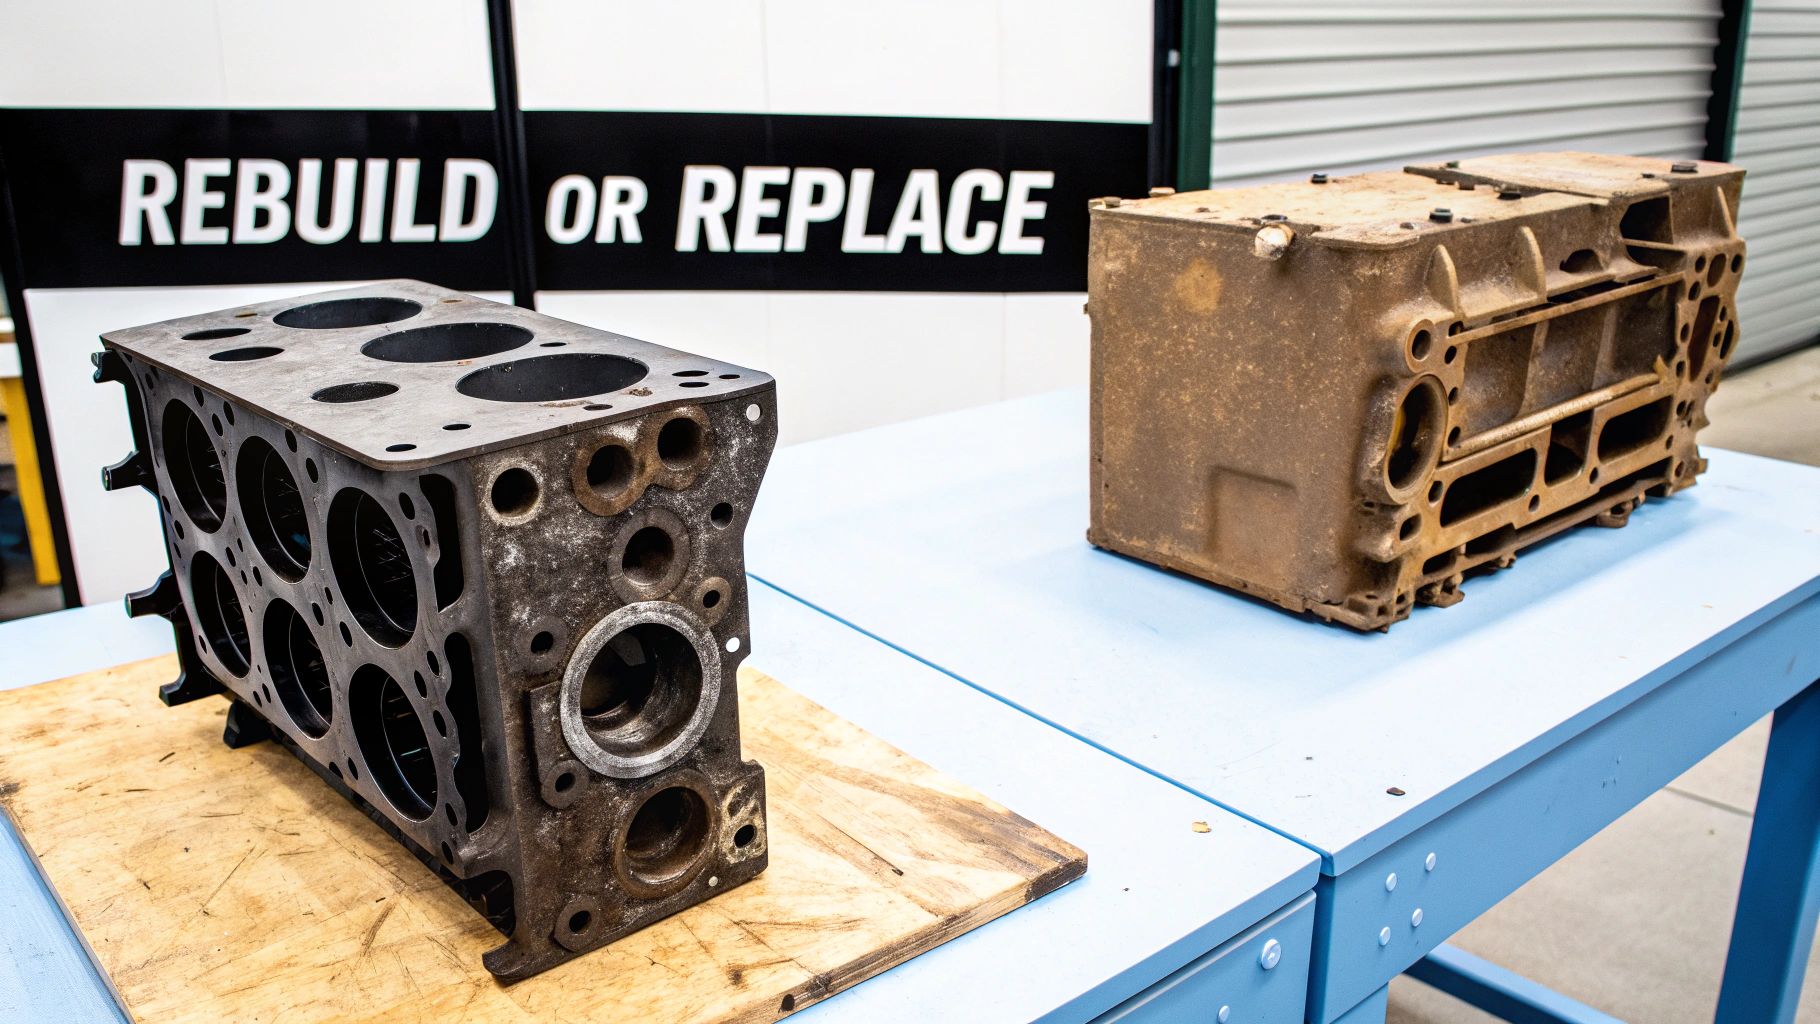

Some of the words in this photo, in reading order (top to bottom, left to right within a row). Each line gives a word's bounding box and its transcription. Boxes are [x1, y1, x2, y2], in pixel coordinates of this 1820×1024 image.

[120, 158, 498, 245] REBUILD
[546, 175, 647, 244] OR
[675, 165, 1054, 254] REPLACE
